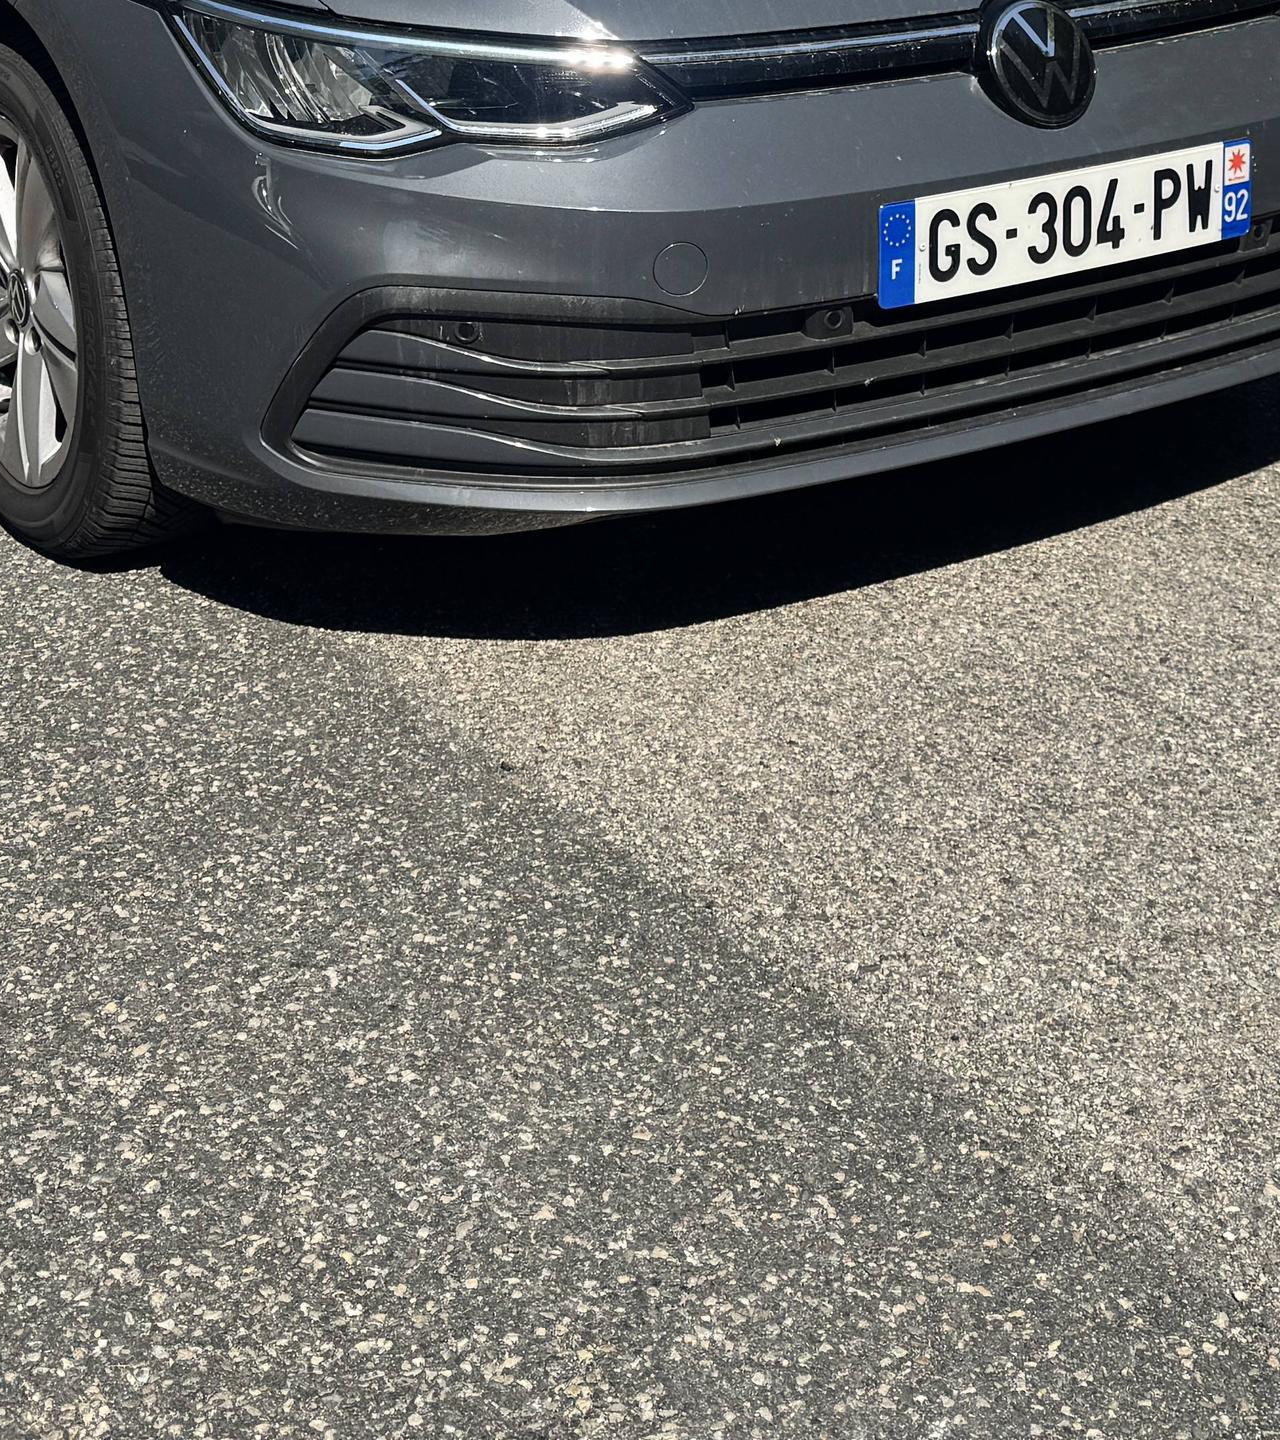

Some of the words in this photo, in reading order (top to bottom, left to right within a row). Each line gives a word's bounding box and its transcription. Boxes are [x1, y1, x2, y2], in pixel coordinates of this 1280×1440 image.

[928, 159, 1214, 283] GS-304-PW
[1223, 188, 1249, 223] 92
[890, 258, 903, 280] F
